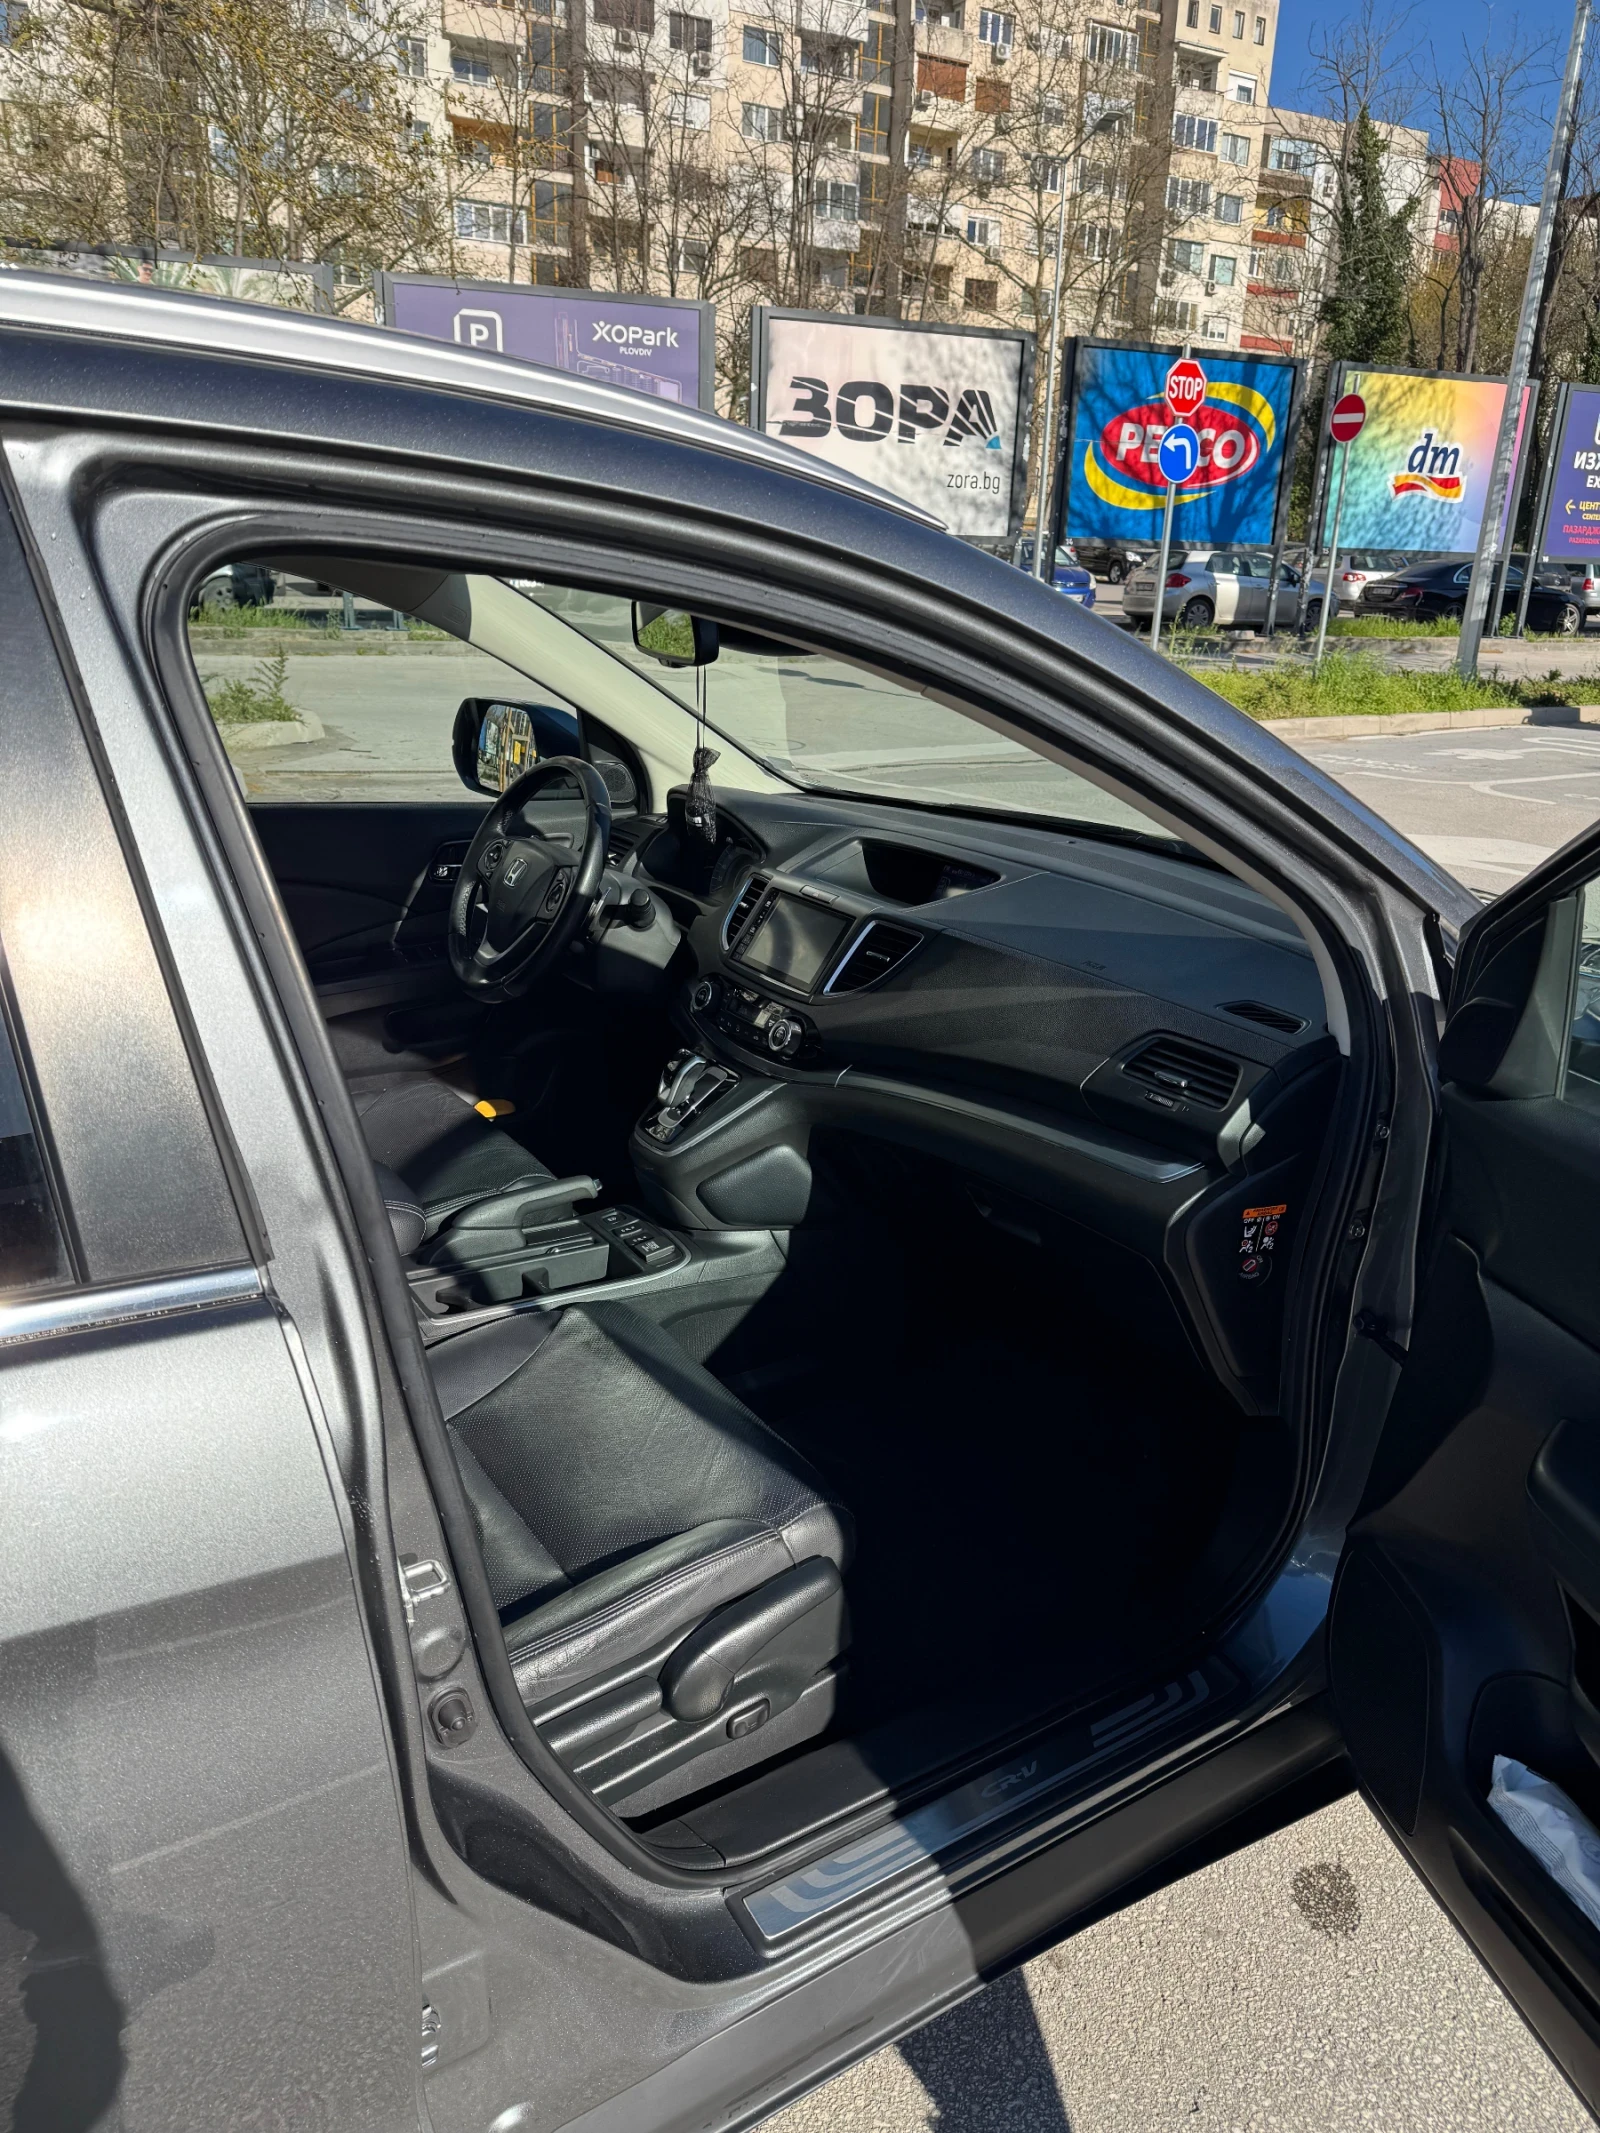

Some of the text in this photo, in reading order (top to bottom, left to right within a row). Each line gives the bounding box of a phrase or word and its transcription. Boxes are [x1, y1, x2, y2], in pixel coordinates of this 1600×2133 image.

[619, 346, 652, 357] PLOVDIV
[1168, 375, 1203, 401] STOP
[779, 376, 999, 447] ЗОРА
[1116, 422, 1245, 469] PECO
[1407, 433, 1460, 475] dm
[947, 472, 1001, 494] zora.bg
[1579, 500, 1600, 512] ЦЕНТ
